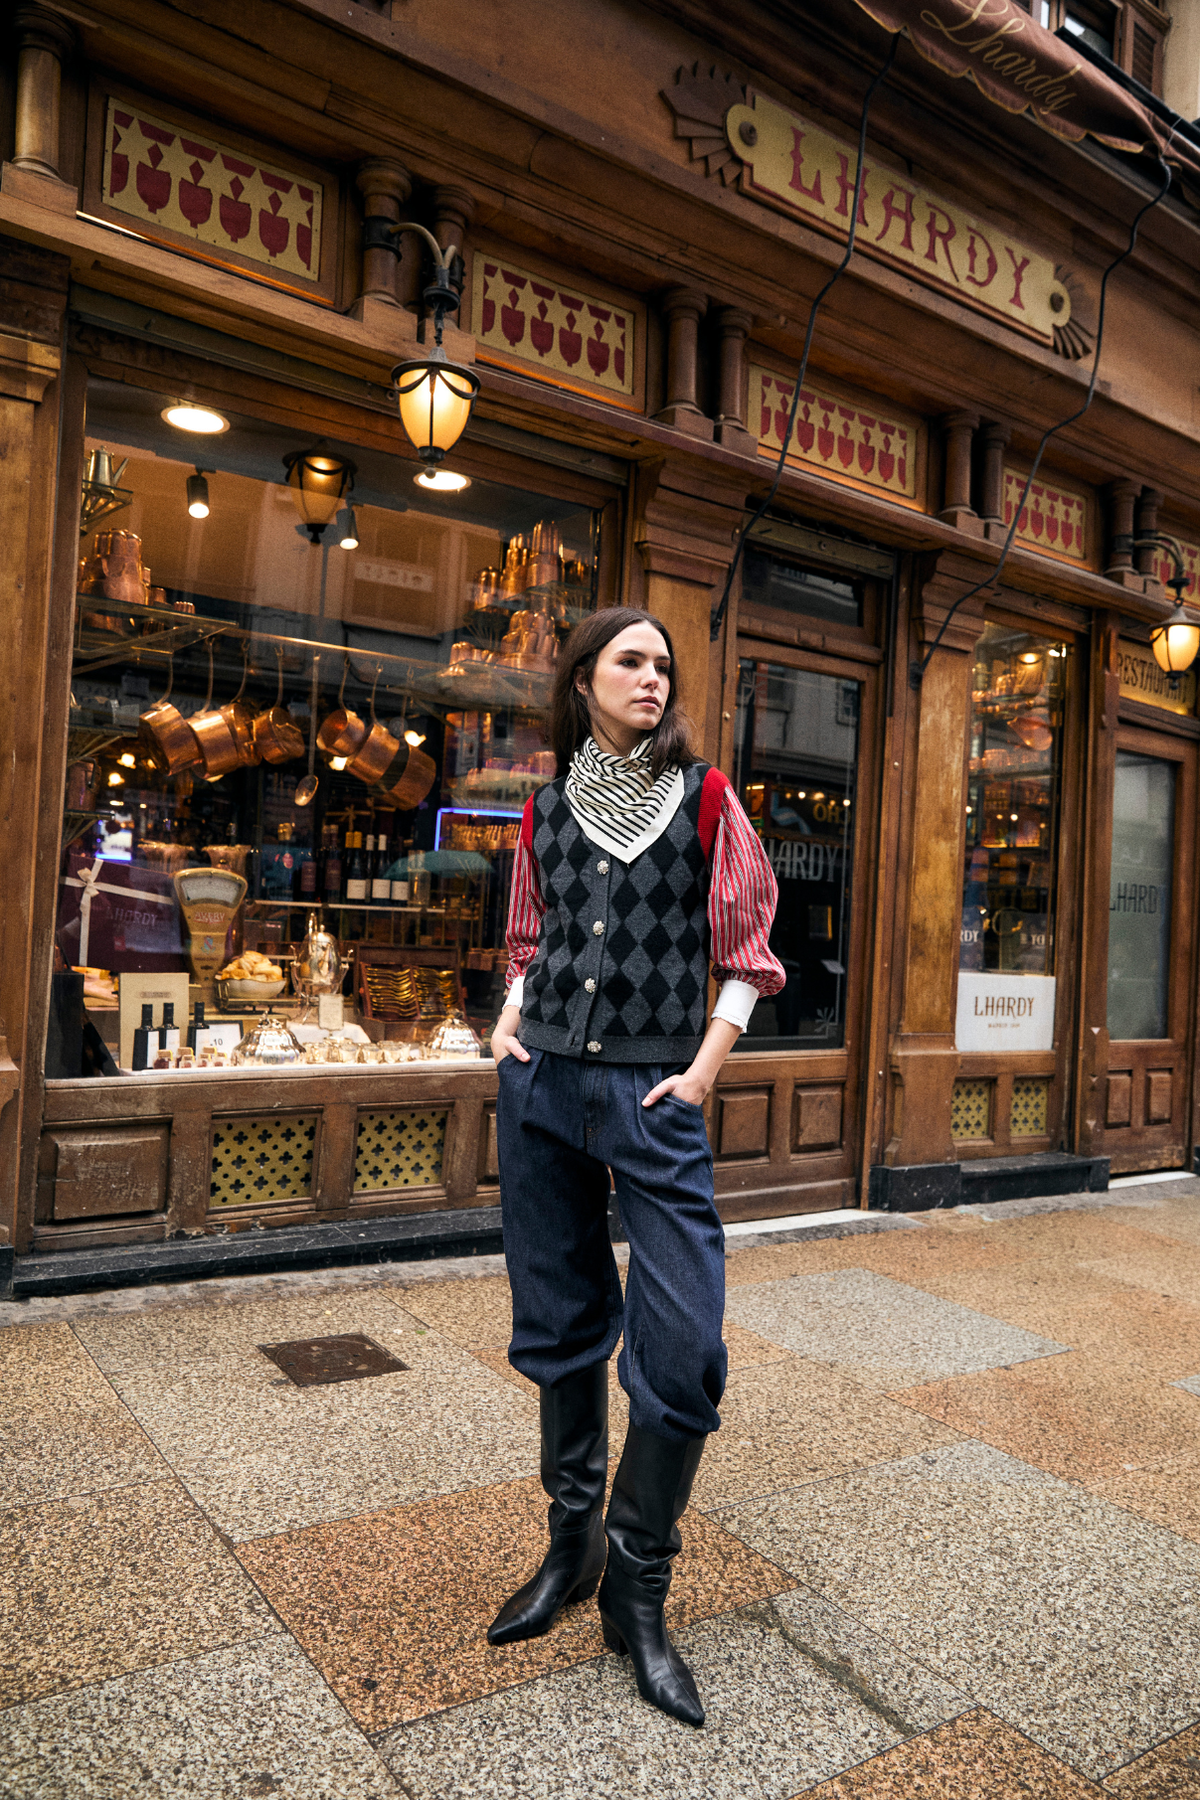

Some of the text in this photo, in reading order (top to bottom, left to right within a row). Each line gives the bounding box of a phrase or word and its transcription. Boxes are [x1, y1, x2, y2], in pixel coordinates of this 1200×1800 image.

[920, 0, 1082, 114] Lhardy
[788, 126, 1030, 310] LHARDY
[974, 996, 1034, 1018] LHARDY
